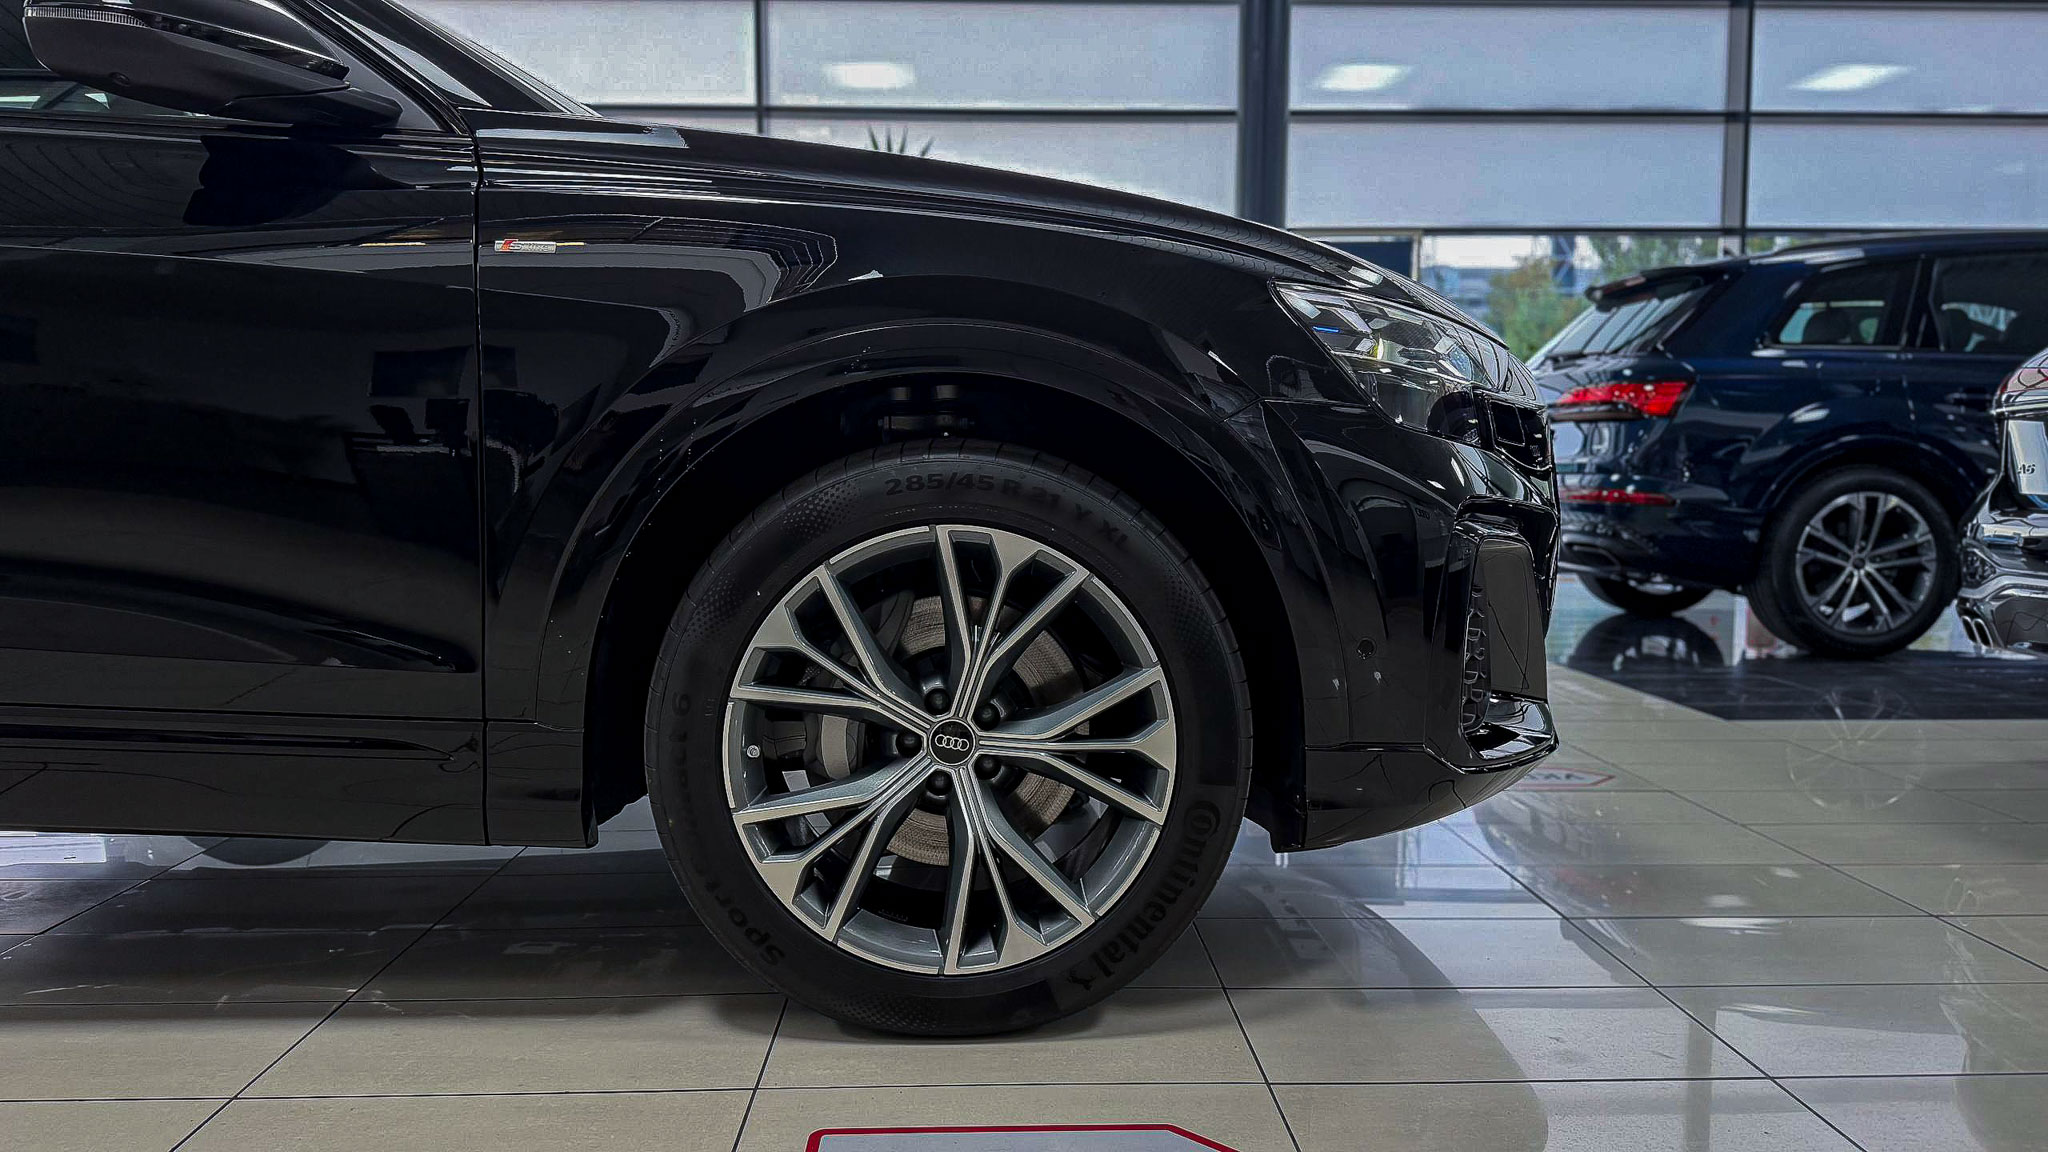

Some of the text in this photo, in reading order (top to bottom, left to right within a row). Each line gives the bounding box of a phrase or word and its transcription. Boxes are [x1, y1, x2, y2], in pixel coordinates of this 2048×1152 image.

[884, 473, 995, 497] 285/45
[1001, 478, 1022, 498] R
[1087, 800, 1222, 978] Continental
